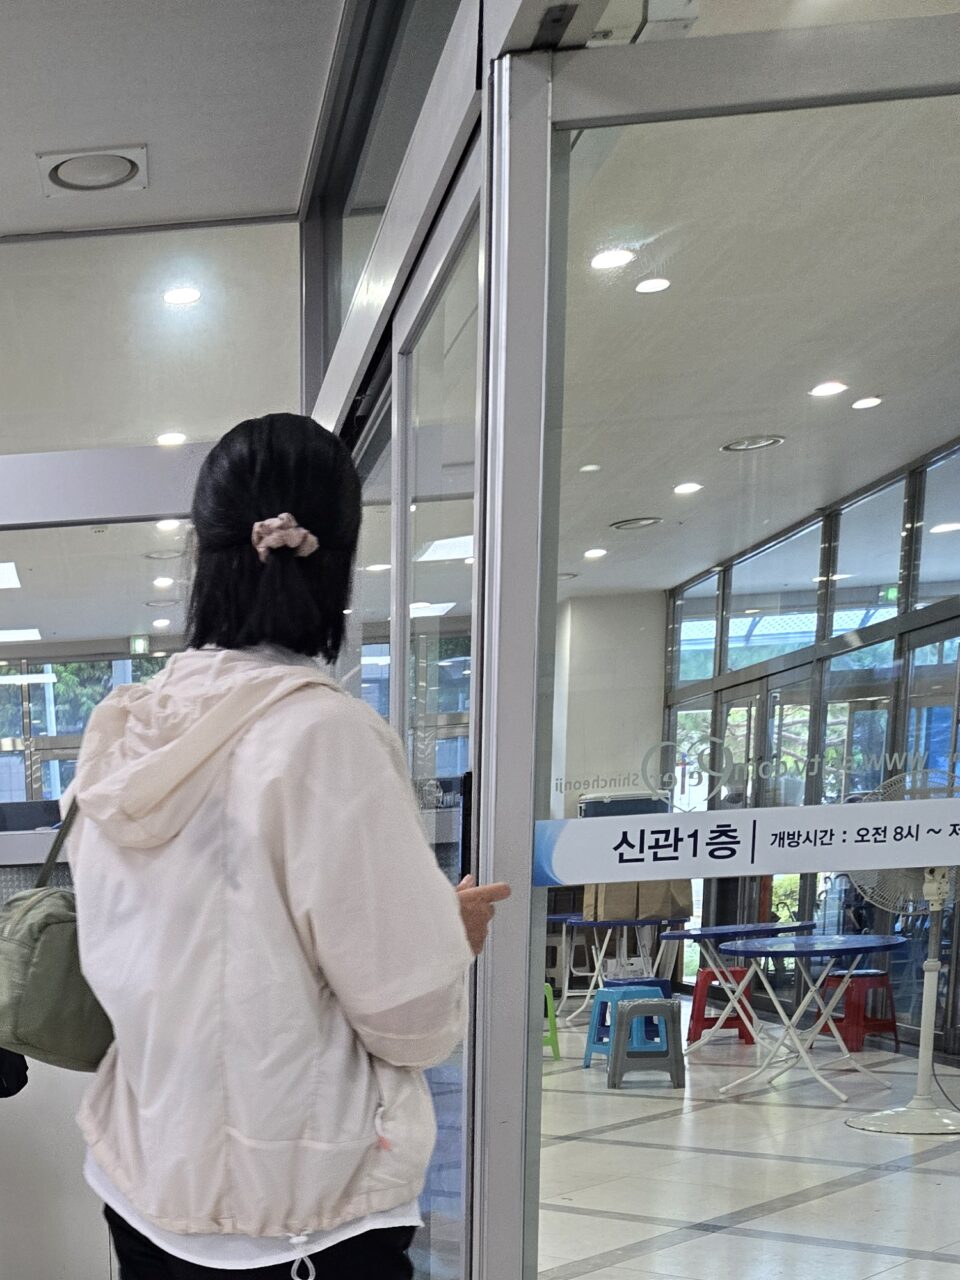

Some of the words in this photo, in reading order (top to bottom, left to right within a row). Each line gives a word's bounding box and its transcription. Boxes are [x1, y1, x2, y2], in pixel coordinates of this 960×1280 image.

[612, 823, 741, 864] 신관1층
[770, 828, 835, 848] 개방시간
[854, 825, 888, 844] 오전
[893, 823, 920, 842] 8시
